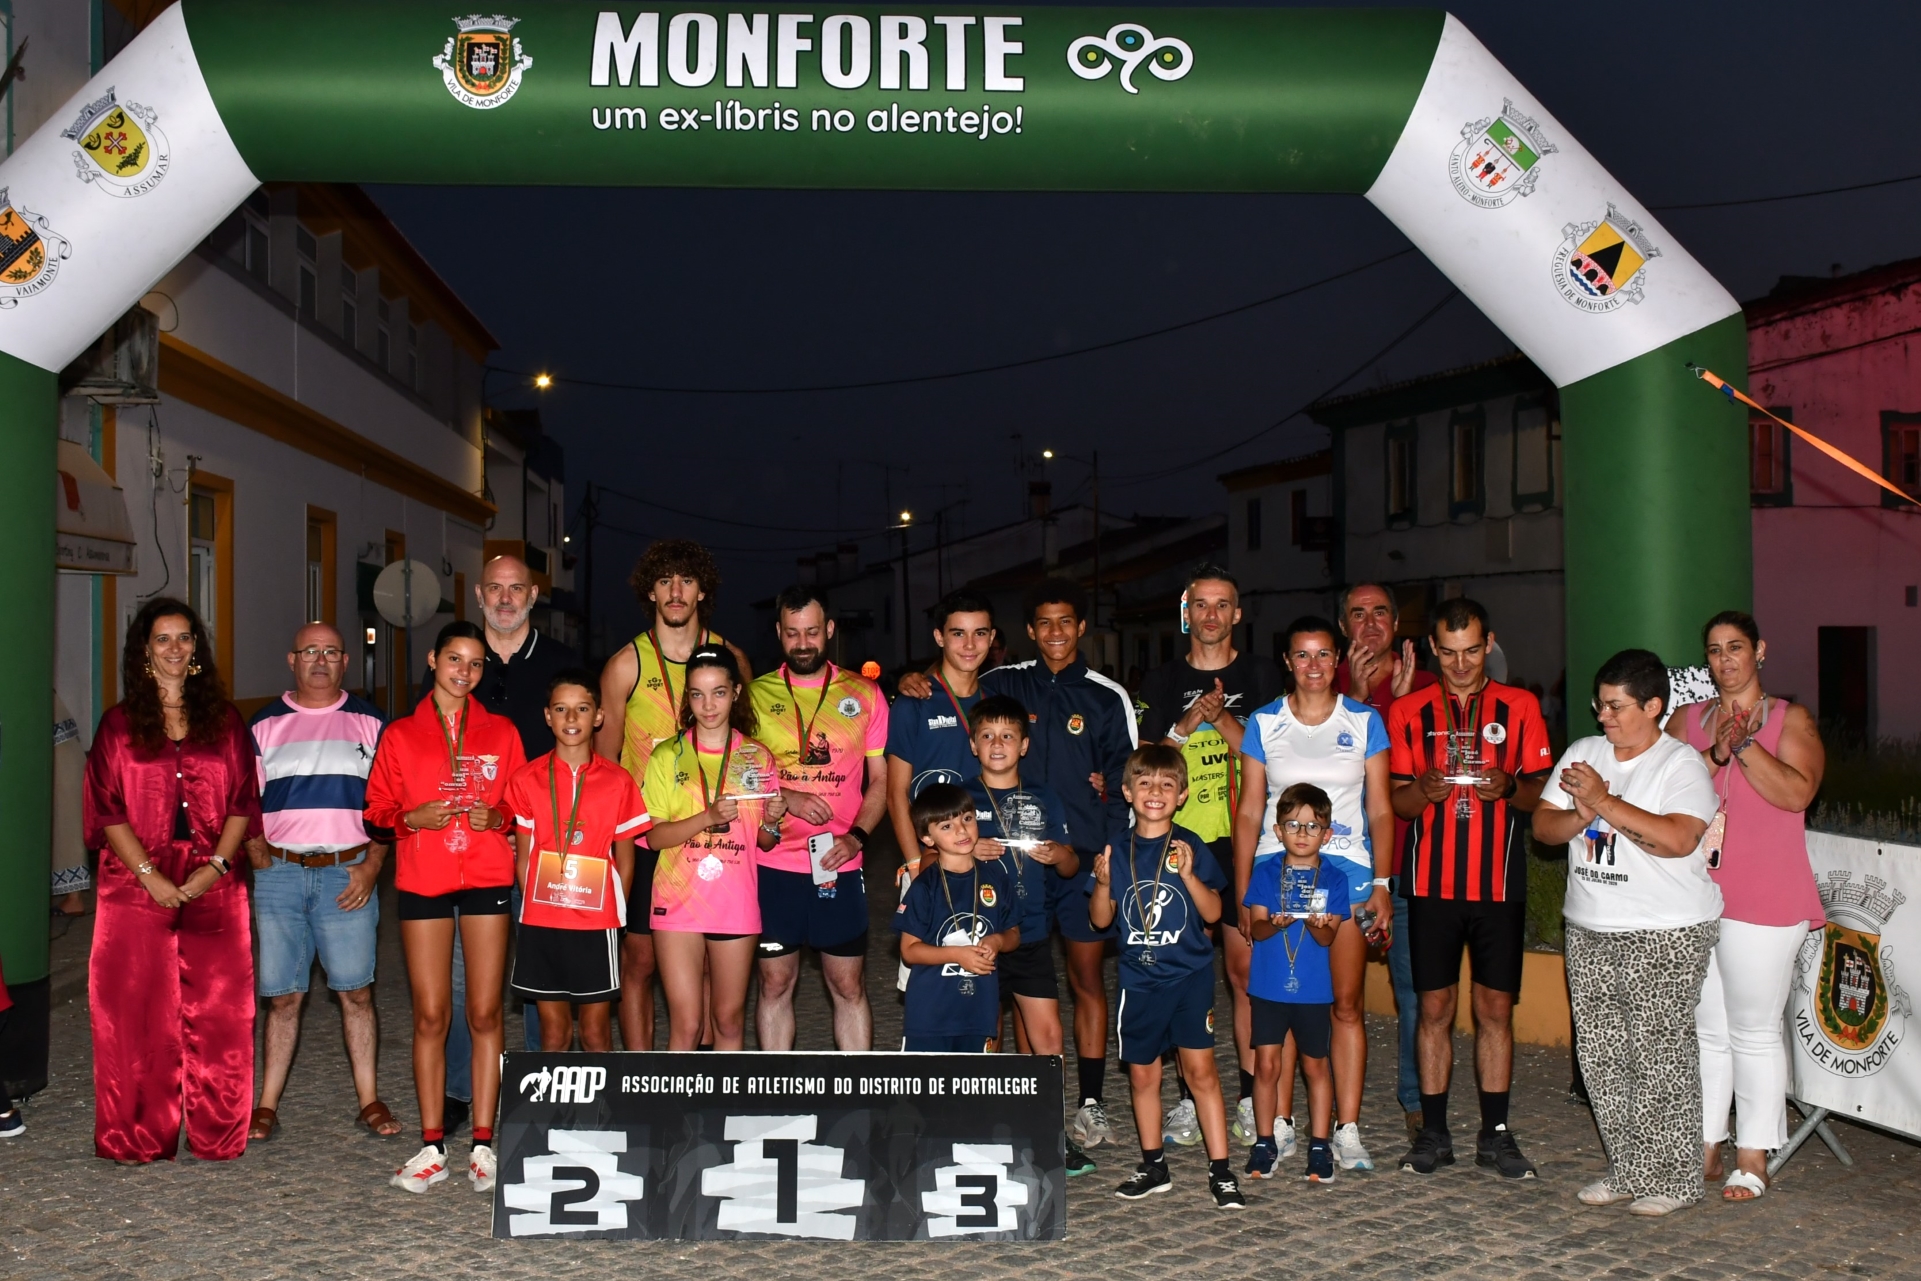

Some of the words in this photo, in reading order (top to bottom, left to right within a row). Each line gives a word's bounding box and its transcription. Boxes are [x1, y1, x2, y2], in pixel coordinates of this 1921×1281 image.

[589, 11, 1026, 93] MONFORTE
[447, 78, 461, 98] VILA
[461, 94, 474, 105] DE
[475, 78, 519, 107] MONFORTE
[592, 105, 647, 132] um
[658, 99, 801, 133] ex-líbris
[810, 108, 856, 133] no
[866, 103, 1024, 141] alentejo!
[123, 154, 168, 196] ASSUMAR
[1450, 152, 1460, 175] SANTO
[1453, 175, 1470, 196] ALEIXO
[1471, 194, 1505, 207] MONFORTE
[15, 257, 58, 296] VAIAMONTE
[1554, 246, 1569, 291] FREGUESIA
[1563, 289, 1576, 301] DE
[1575, 297, 1620, 312] MONFORTE
[1183, 689, 1203, 698] TEAM
[780, 769, 798, 781] Pão
[811, 769, 846, 788] Antiga
[1191, 771, 1225, 783] MASTERS
[684, 838, 700, 849] Pão
[712, 838, 746, 856] Antiga
[564, 859, 578, 880] 5
[1574, 864, 1588, 877] JOSÉ
[1590, 869, 1599, 879] DO
[1601, 871, 1629, 882] CARMO
[547, 881, 567, 891] André
[568, 884, 592, 894] Vitória
[1795, 1009, 1815, 1046] VILA
[1811, 1041, 1832, 1064] DE
[1830, 1030, 1899, 1074] MONFORTE
[550, 1066, 607, 1104] AADP
[621, 1073, 714, 1098] ASSOCIAÇÃO
[722, 1076, 740, 1095] DE
[747, 1076, 826, 1095] ATLETISMO
[834, 1076, 853, 1095] DO
[859, 1077, 922, 1095] DISTRITO
[929, 1077, 946, 1095] DE
[952, 1077, 1038, 1096] PORTALEGRE
[762, 1138, 798, 1224] 1
[549, 1166, 600, 1226] 2
[955, 1174, 999, 1229] 3
